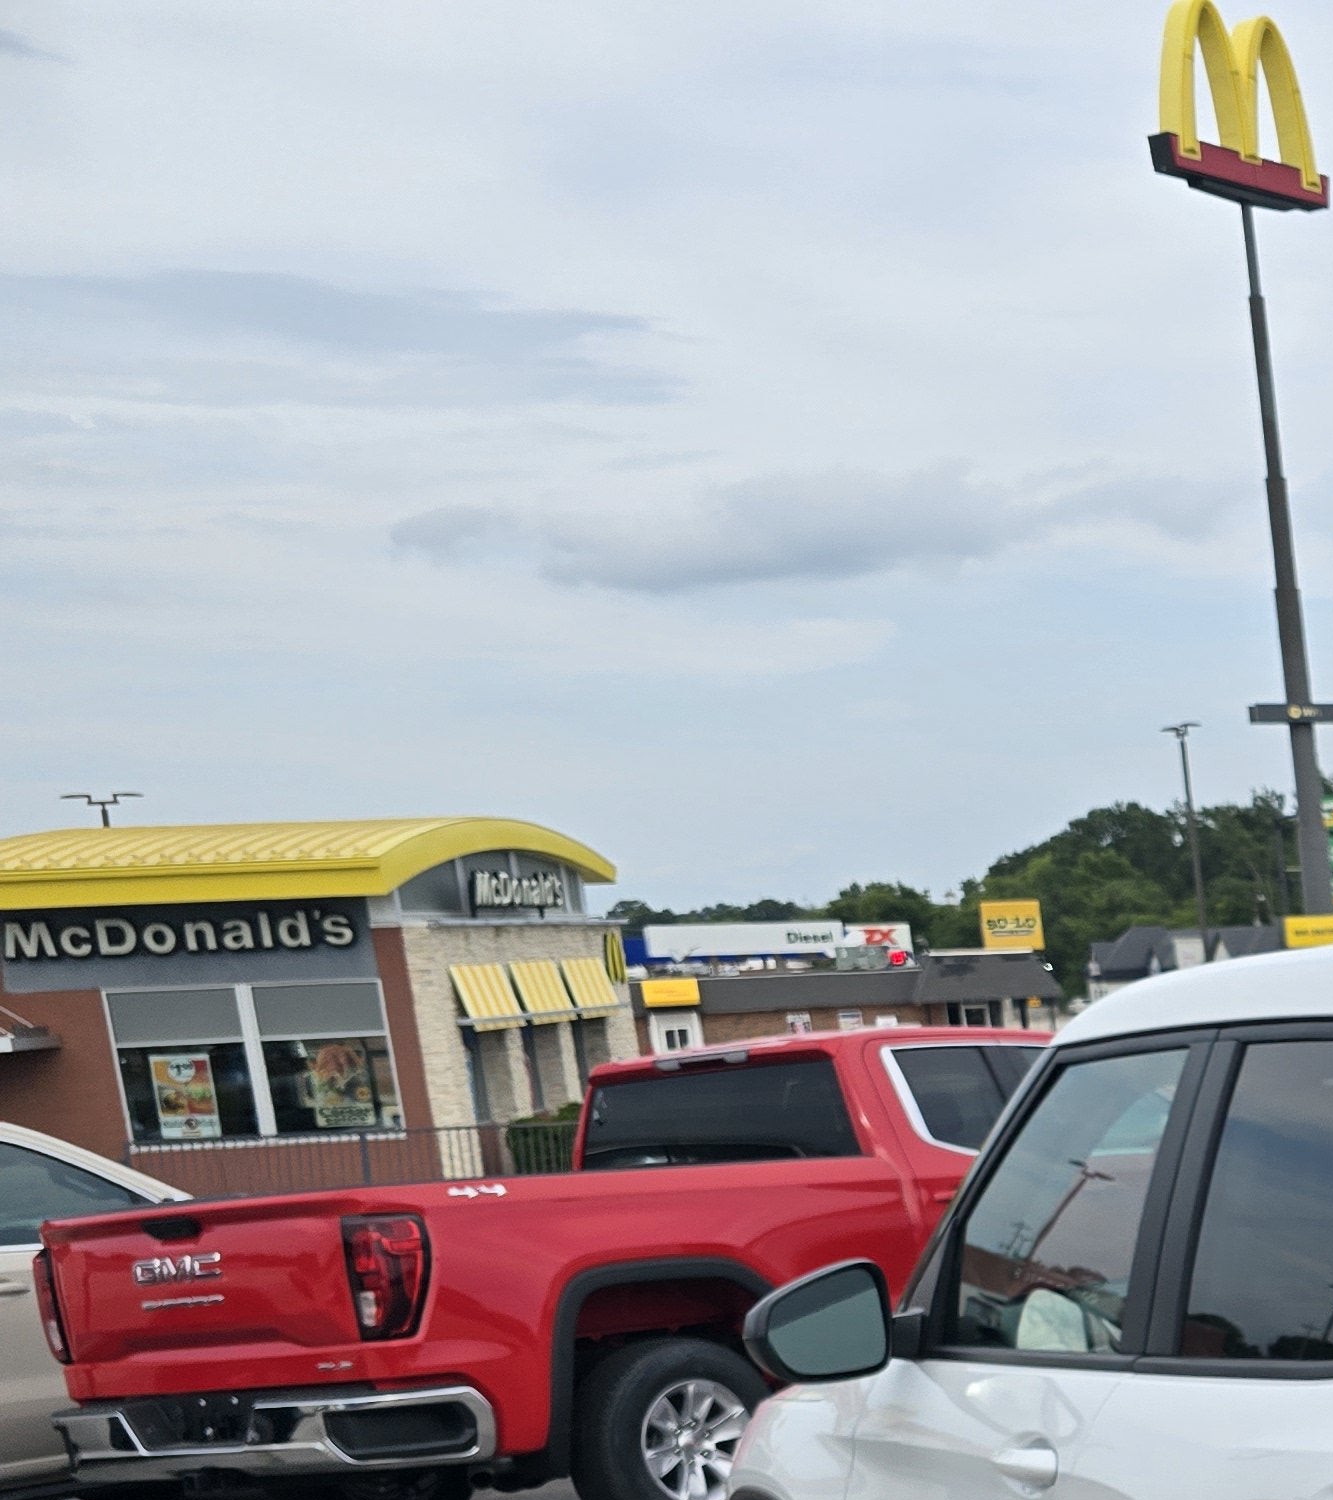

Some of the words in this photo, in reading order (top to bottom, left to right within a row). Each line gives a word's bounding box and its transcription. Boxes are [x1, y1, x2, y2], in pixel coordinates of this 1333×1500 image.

[474, 869, 564, 907] McDonald's
[4, 901, 354, 959] McDonald's
[786, 930, 835, 945] Diesel
[133, 1251, 223, 1285] GMC
